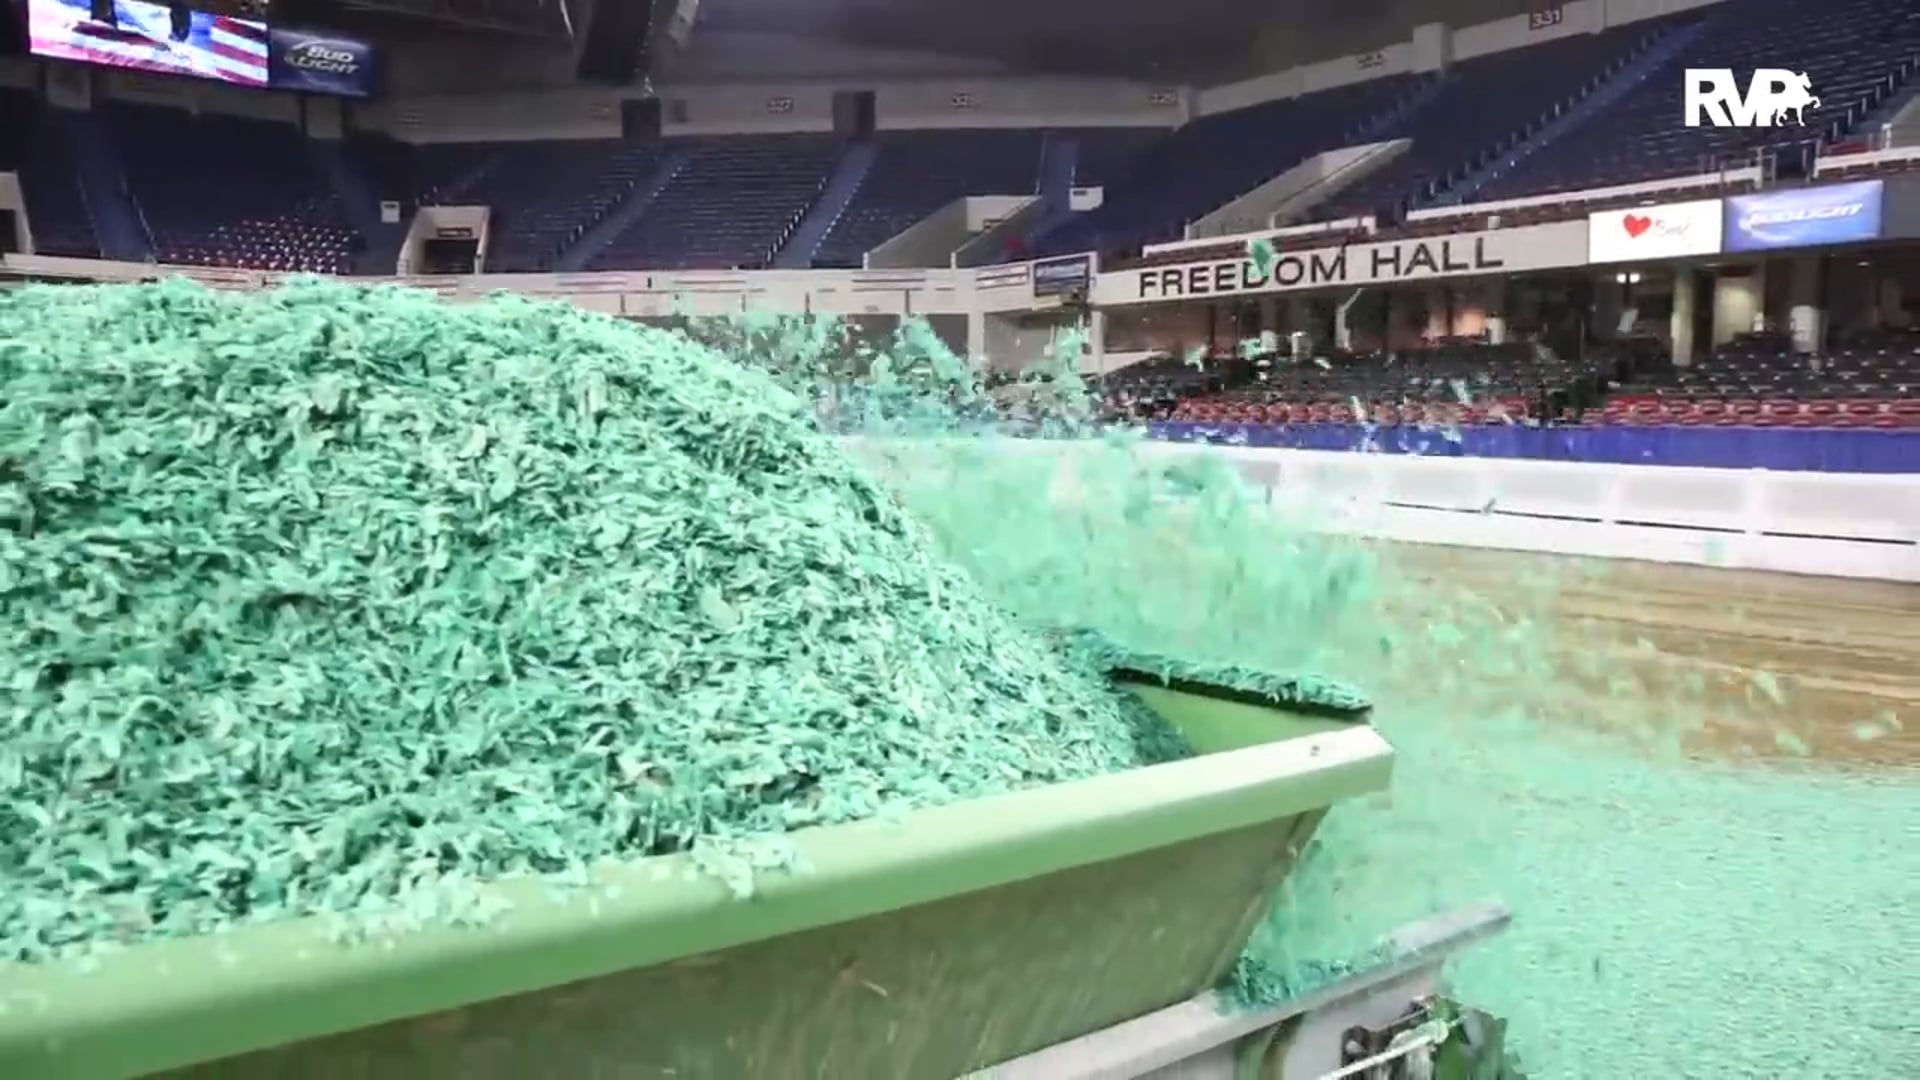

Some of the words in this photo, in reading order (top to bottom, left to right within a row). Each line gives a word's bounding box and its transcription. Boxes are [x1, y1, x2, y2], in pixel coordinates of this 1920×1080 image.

[1532, 9, 1561, 28] 331
[307, 46, 354, 62] BUD
[297, 57, 359, 74] LIGHT
[1371, 238, 1504, 278] HALL
